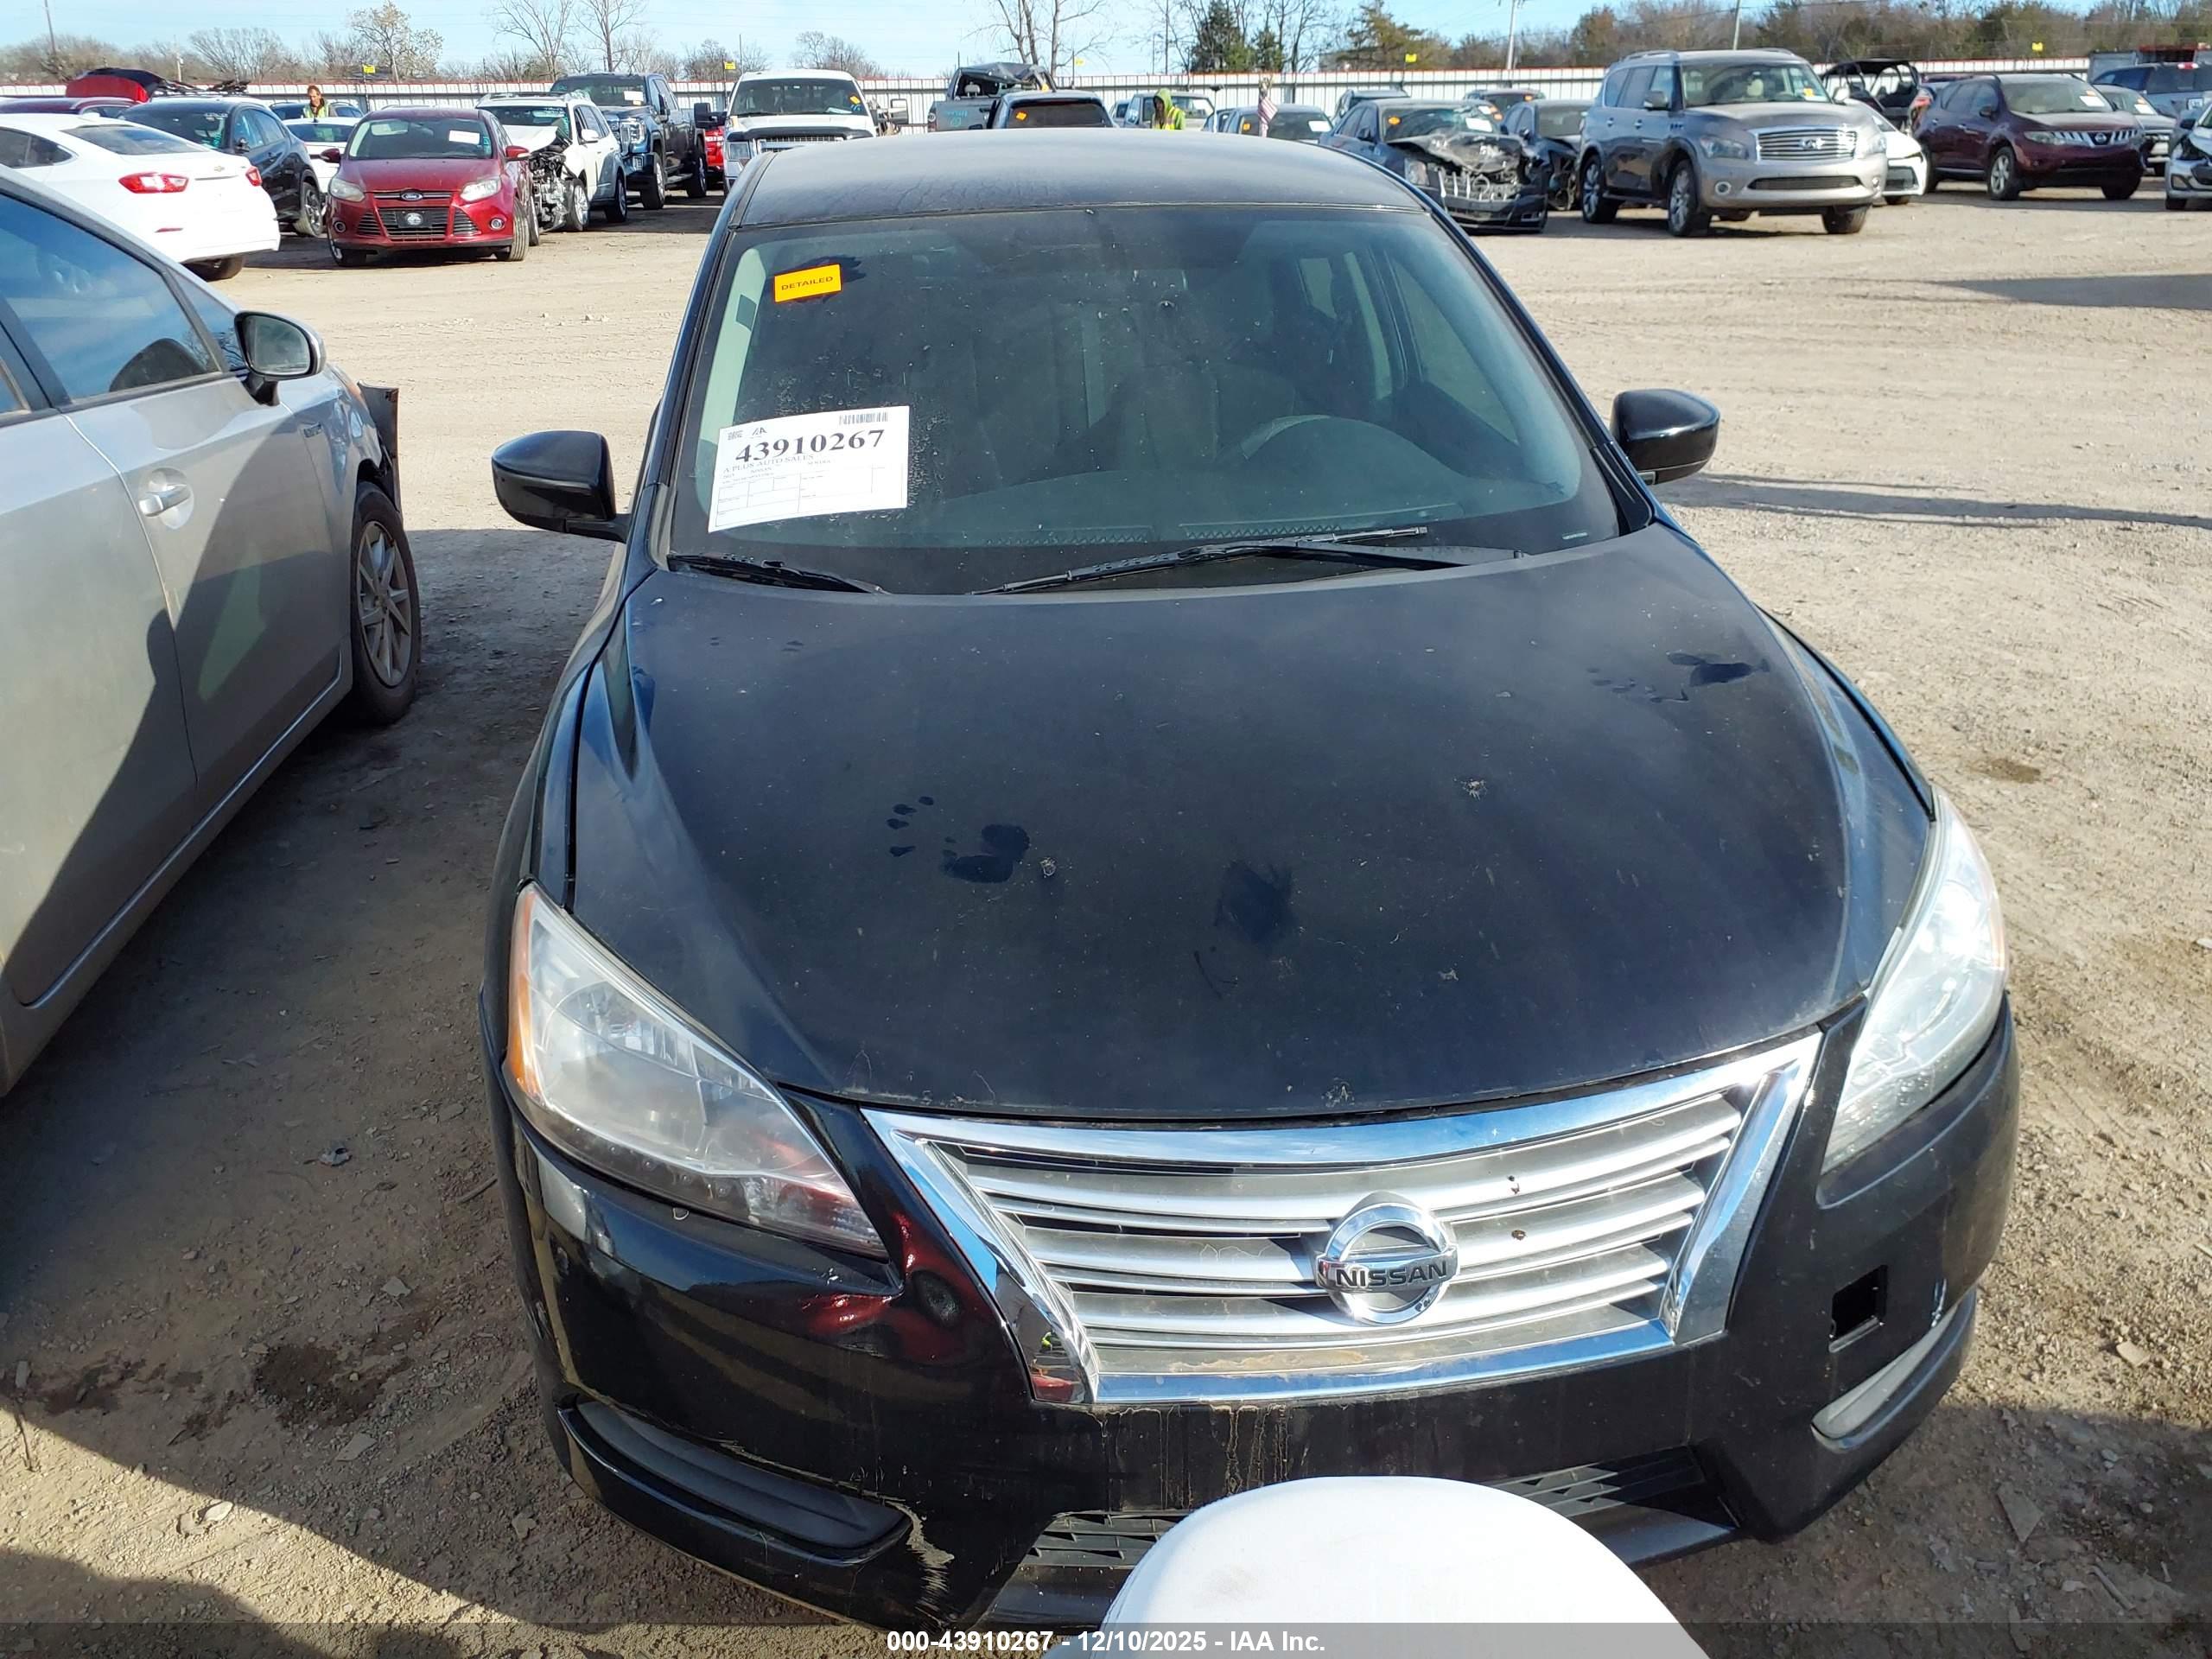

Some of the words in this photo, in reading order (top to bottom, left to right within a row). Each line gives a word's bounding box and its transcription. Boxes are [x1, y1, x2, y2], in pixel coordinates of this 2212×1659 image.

[781, 276, 834, 290] DETAILED
[734, 429, 885, 462] 43910267
[732, 463, 754, 472] PLUS
[759, 458, 784, 467] AUTO
[785, 454, 814, 463] SALES
[1335, 1260, 1447, 1287] NISSAN
